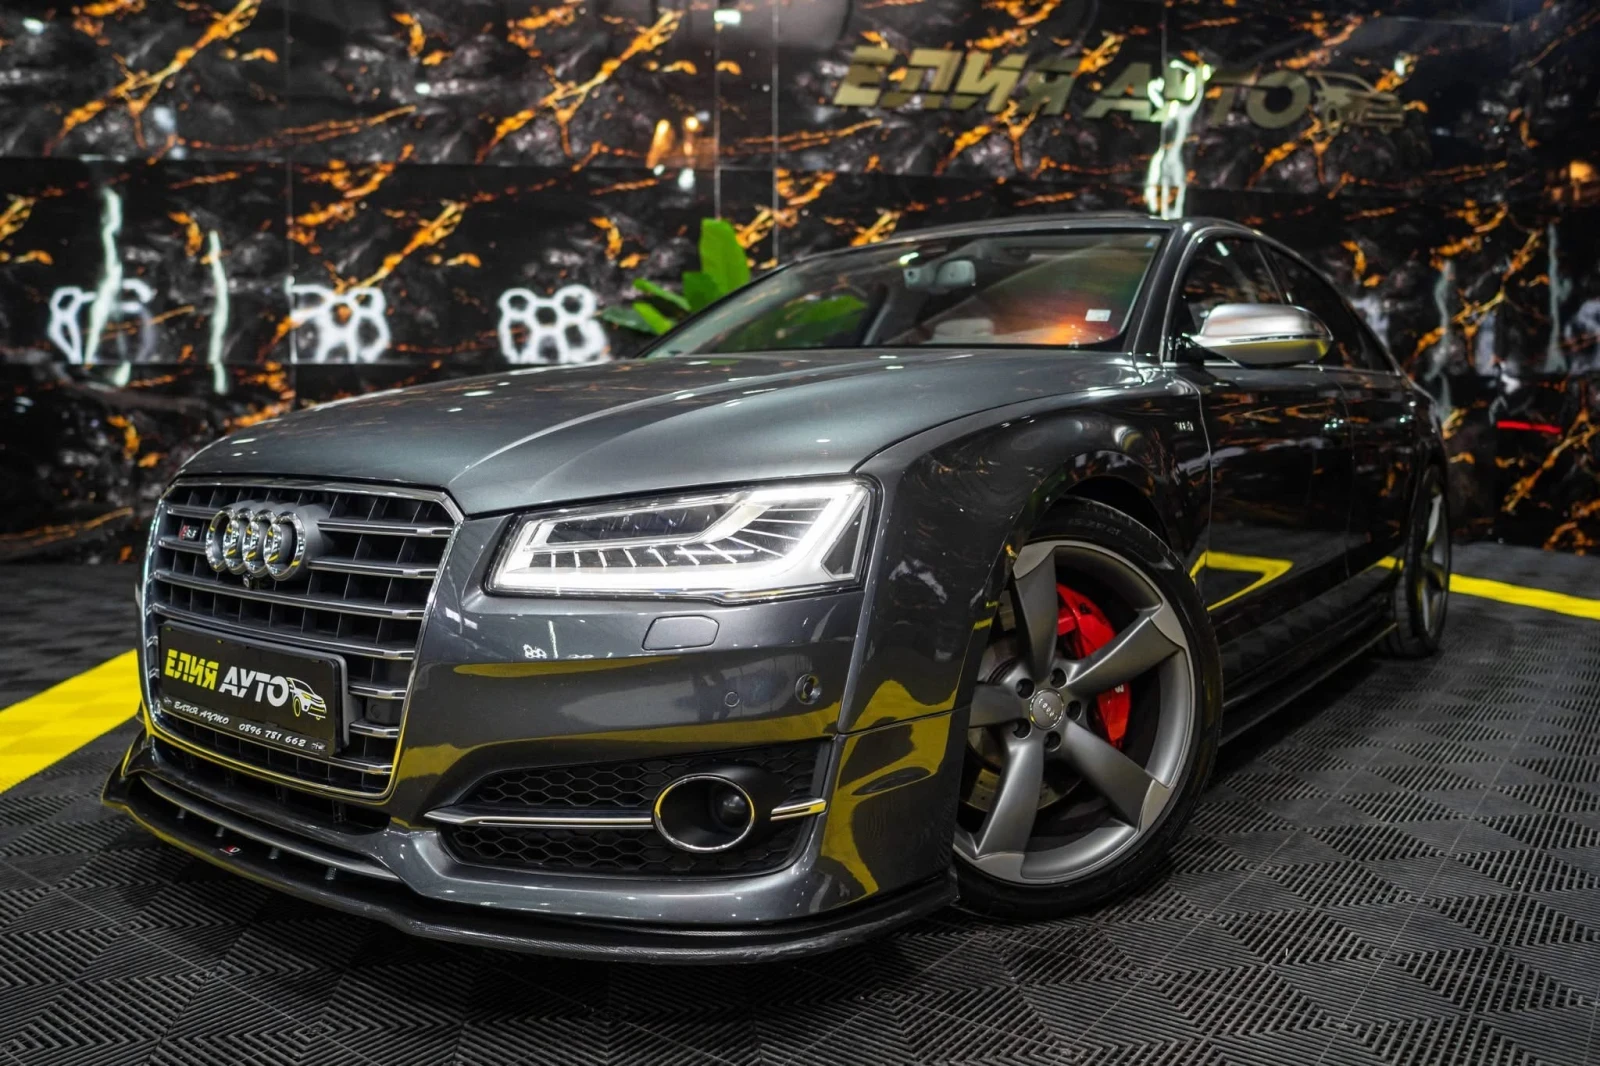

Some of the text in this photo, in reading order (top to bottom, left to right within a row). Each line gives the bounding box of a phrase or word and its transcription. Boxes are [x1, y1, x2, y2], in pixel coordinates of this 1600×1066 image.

[833, 45, 1081, 116] ЕЛИЯ
[164, 649, 289, 707] ЕЛИЯ АУТО
[238, 723, 262, 736] 0896
[265, 730, 283, 741] 781
[285, 735, 307, 747] 662
